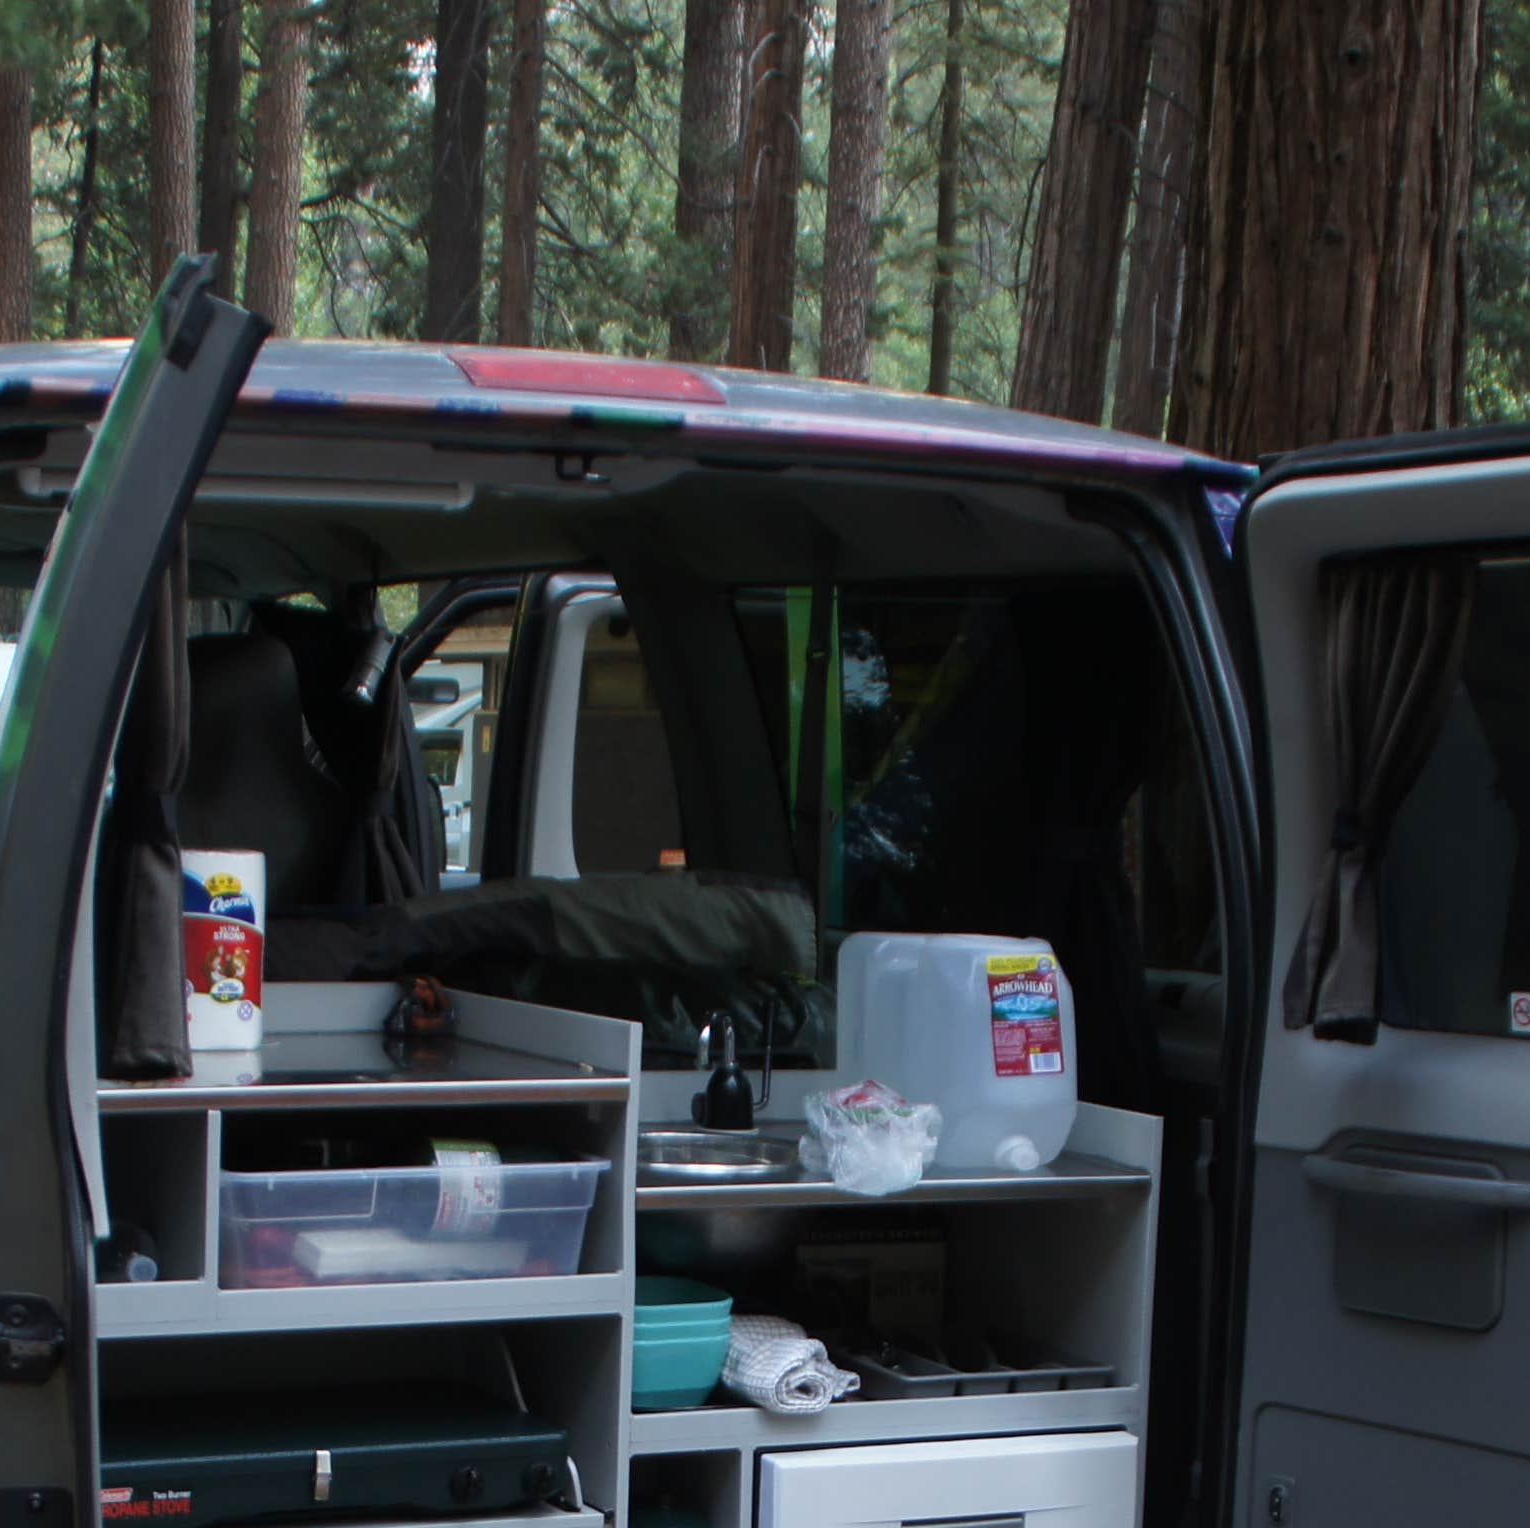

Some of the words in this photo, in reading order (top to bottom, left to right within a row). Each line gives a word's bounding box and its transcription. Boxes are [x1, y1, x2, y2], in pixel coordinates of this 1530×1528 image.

[209, 895, 250, 914] Charmin
[213, 931, 245, 941] STRONG
[993, 980, 1053, 996] ARROWHEAD
[102, 1501, 150, 1518] ROPANE
[153, 1499, 192, 1515] STOVE
